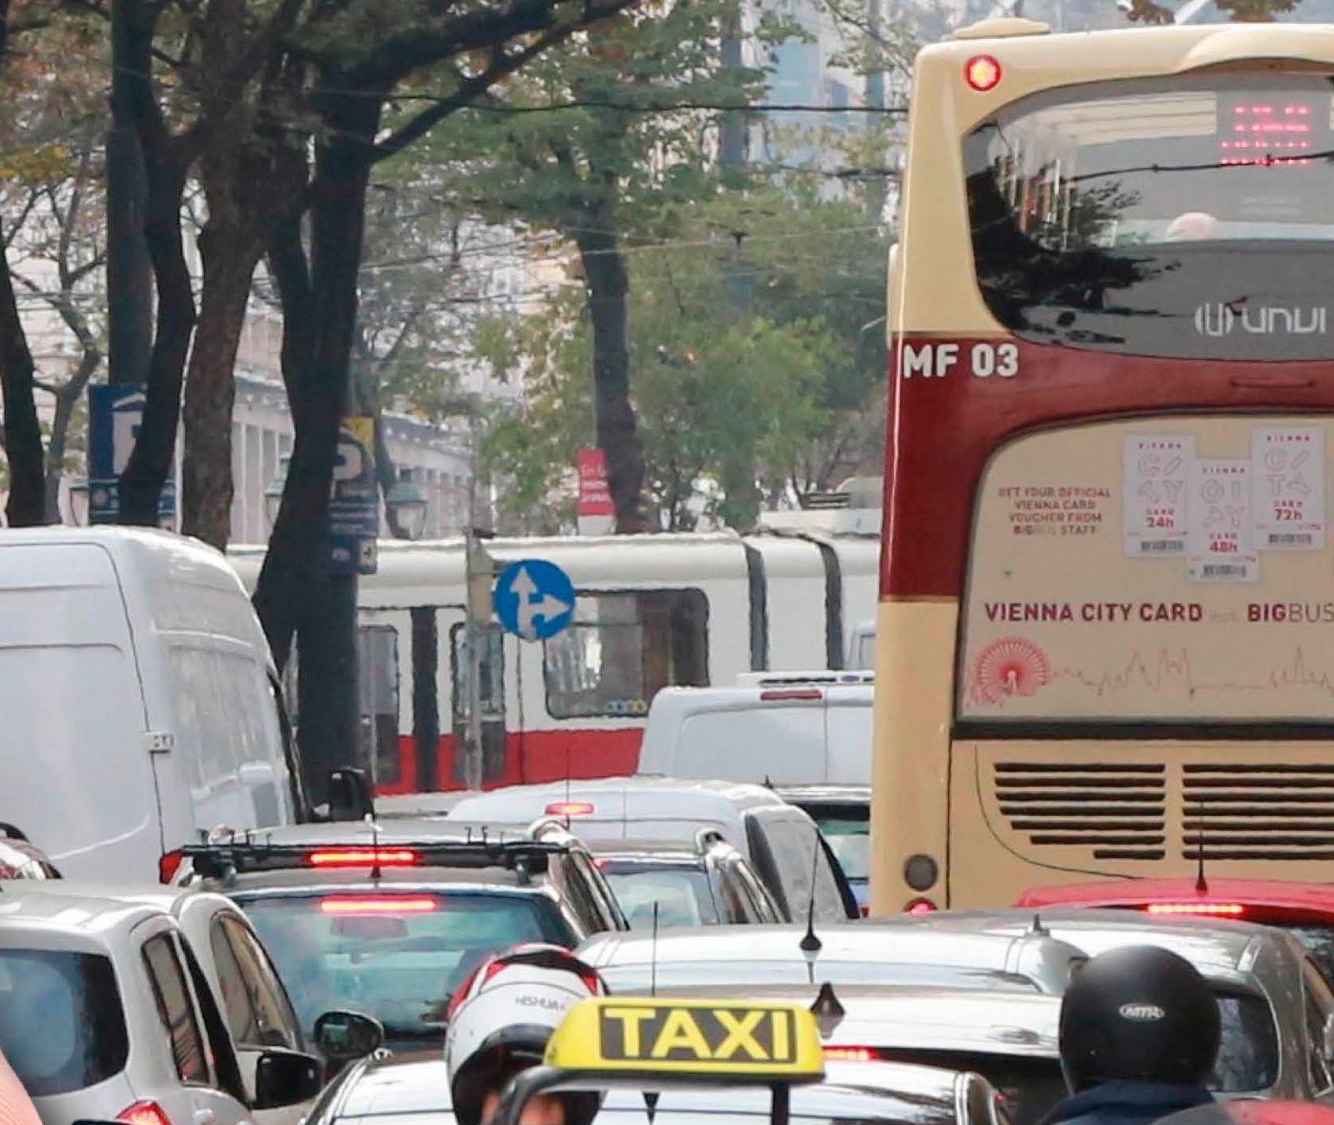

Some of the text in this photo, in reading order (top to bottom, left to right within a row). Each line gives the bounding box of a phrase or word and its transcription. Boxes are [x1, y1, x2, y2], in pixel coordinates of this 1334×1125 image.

[903, 343, 1019, 378] MF 03
[1024, 487, 1055, 498] YOUR
[1058, 487, 1111, 498] OFFICIAL
[1015, 499, 1096, 510] VIENNA CARD
[1010, 512, 1102, 523] VOUCHER FROM
[1274, 508, 1303, 520] 72h
[1146, 517, 1175, 528] 24h
[1060, 524, 1096, 535] STAFF
[1208, 541, 1238, 552] 48h
[984, 603, 1074, 622] VIENNA
[1081, 603, 1133, 622] CITY
[1139, 603, 1203, 622] CARD
[604, 1007, 790, 1060] TAXI
